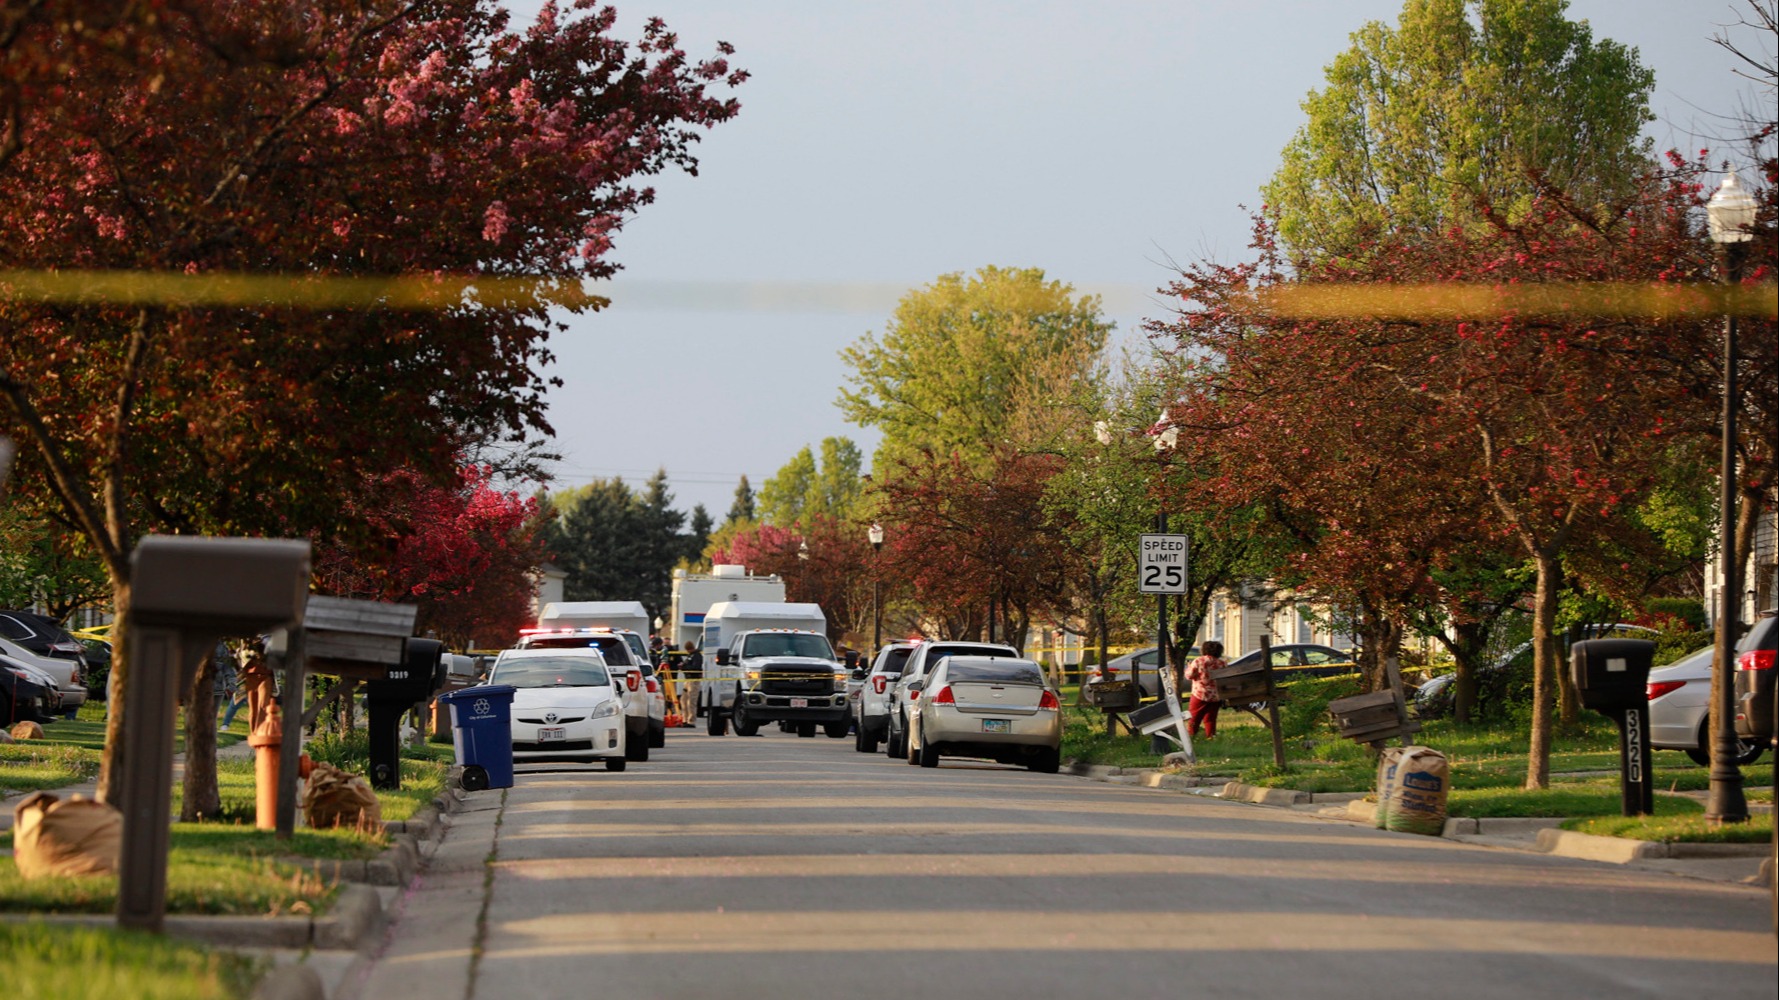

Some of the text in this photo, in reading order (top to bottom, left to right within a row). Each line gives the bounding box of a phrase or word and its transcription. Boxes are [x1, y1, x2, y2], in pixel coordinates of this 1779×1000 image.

[1144, 541, 1183, 551] SPEED
[1148, 553, 1179, 563] LIMIT
[1144, 565, 1182, 587] 25
[1628, 710, 1640, 781] 3220
